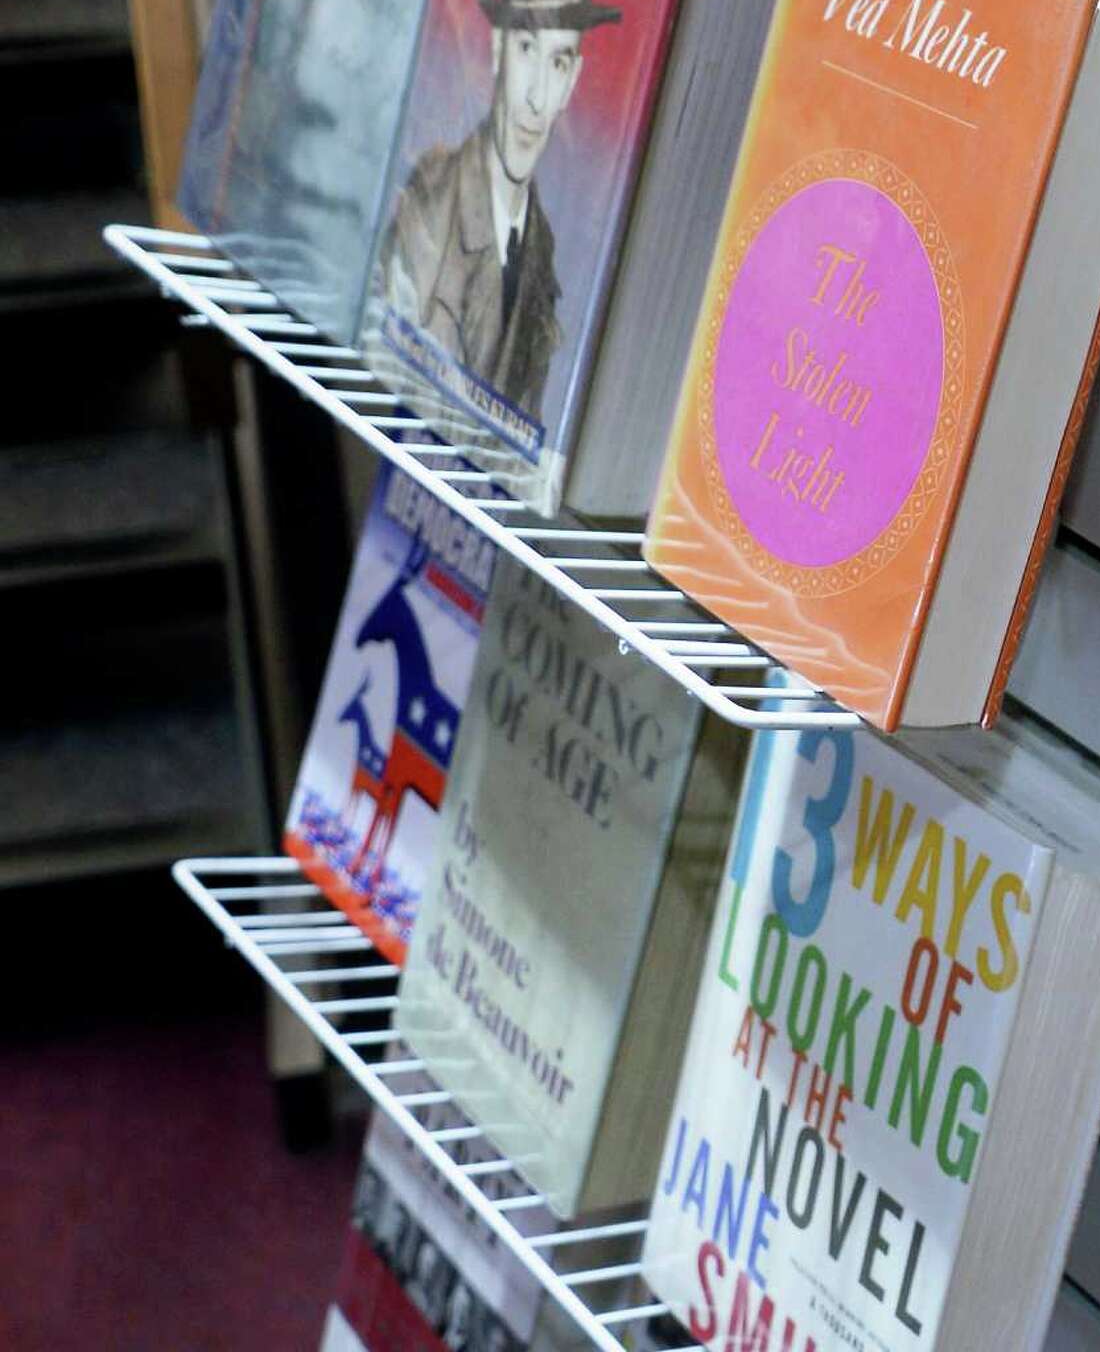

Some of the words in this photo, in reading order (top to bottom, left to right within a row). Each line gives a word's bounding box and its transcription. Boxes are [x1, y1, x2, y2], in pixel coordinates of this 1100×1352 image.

[810, 243, 881, 328] The
[770, 326, 874, 428] Stolen
[749, 410, 846, 515] Light
[485, 665, 530, 744] OF
[502, 600, 664, 784] COMING
[530, 720, 613, 828] AGE
[442, 860, 531, 992] Simone
[850, 773, 1032, 994] WAYS
[454, 946, 575, 1105] Beauvoir
[717, 886, 990, 1184] LOOKING
[901, 935, 974, 1044] OF
[732, 1005, 777, 1080] AT
[786, 1051, 855, 1154] THE
[663, 1116, 780, 1291] JANE
[746, 1086, 927, 1338] NOVEL
